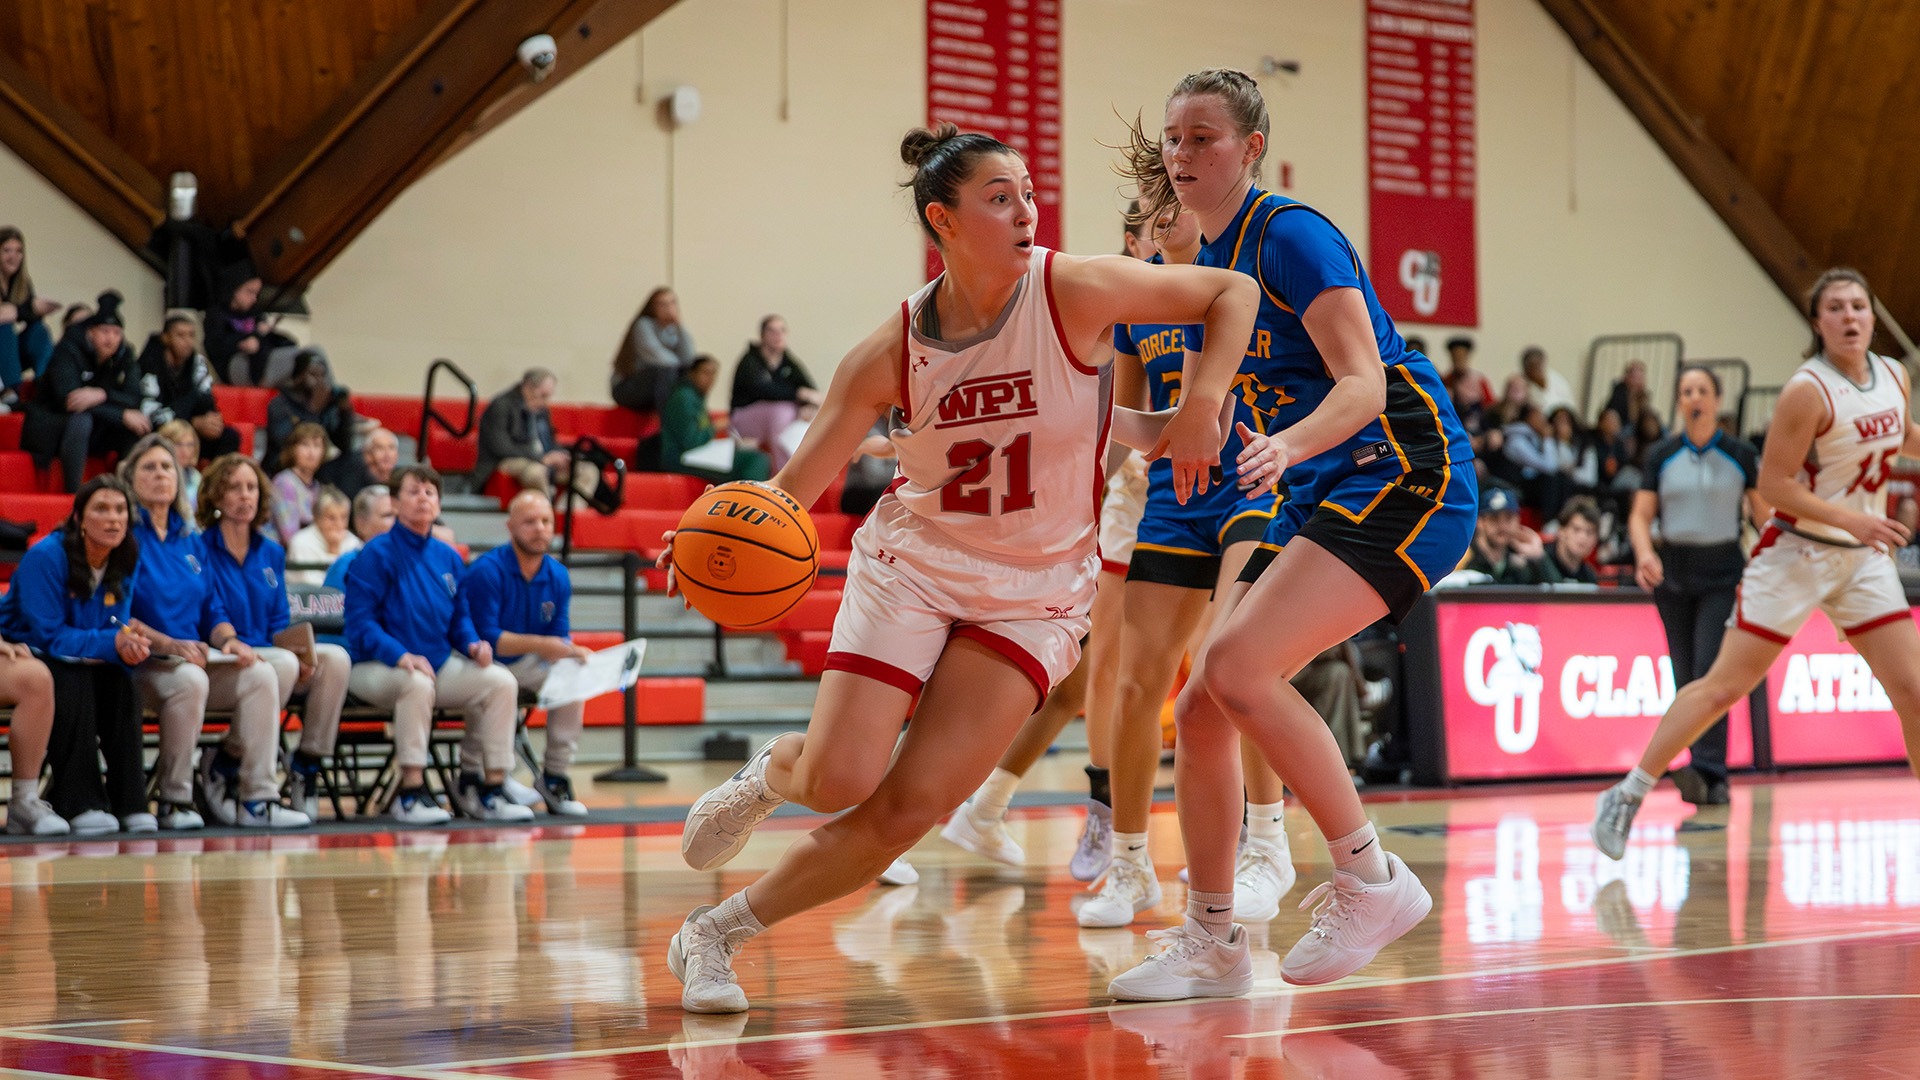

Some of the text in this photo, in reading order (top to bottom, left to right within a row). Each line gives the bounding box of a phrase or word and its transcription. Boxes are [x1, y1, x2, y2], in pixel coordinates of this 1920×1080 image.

[938, 377, 1037, 422] WPI
[1378, 444, 1388, 454] M
[1846, 447, 1898, 497] 15
[940, 432, 1036, 516] 21
[707, 500, 769, 526] EVO
[1464, 622, 1544, 754] CU
